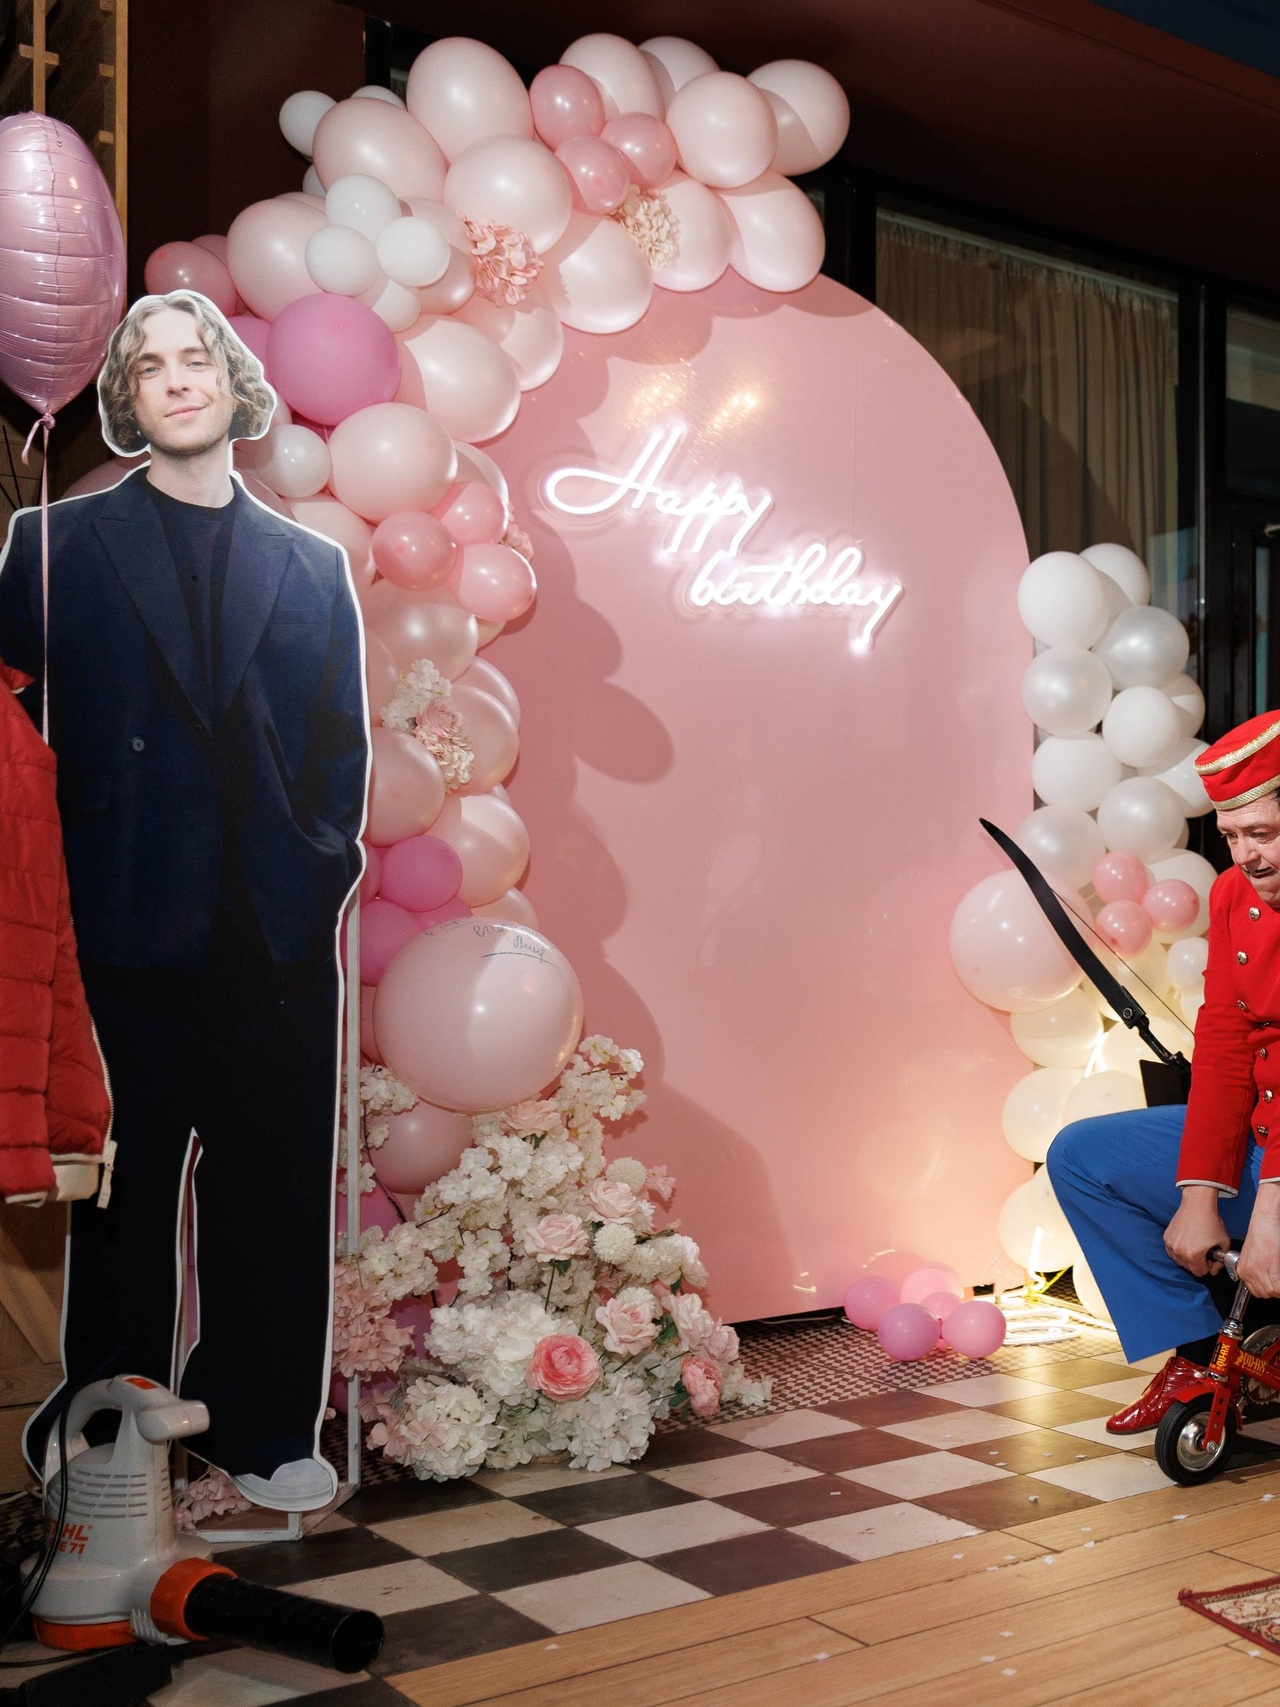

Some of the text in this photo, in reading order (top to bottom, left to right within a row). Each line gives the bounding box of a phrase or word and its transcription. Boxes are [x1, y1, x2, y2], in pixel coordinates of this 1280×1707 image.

[544, 424, 773, 557] Happy
[690, 543, 901, 646] birthday
[1216, 1343, 1230, 1367] QU-AX
[1241, 1352, 1266, 1373] QU-AX
